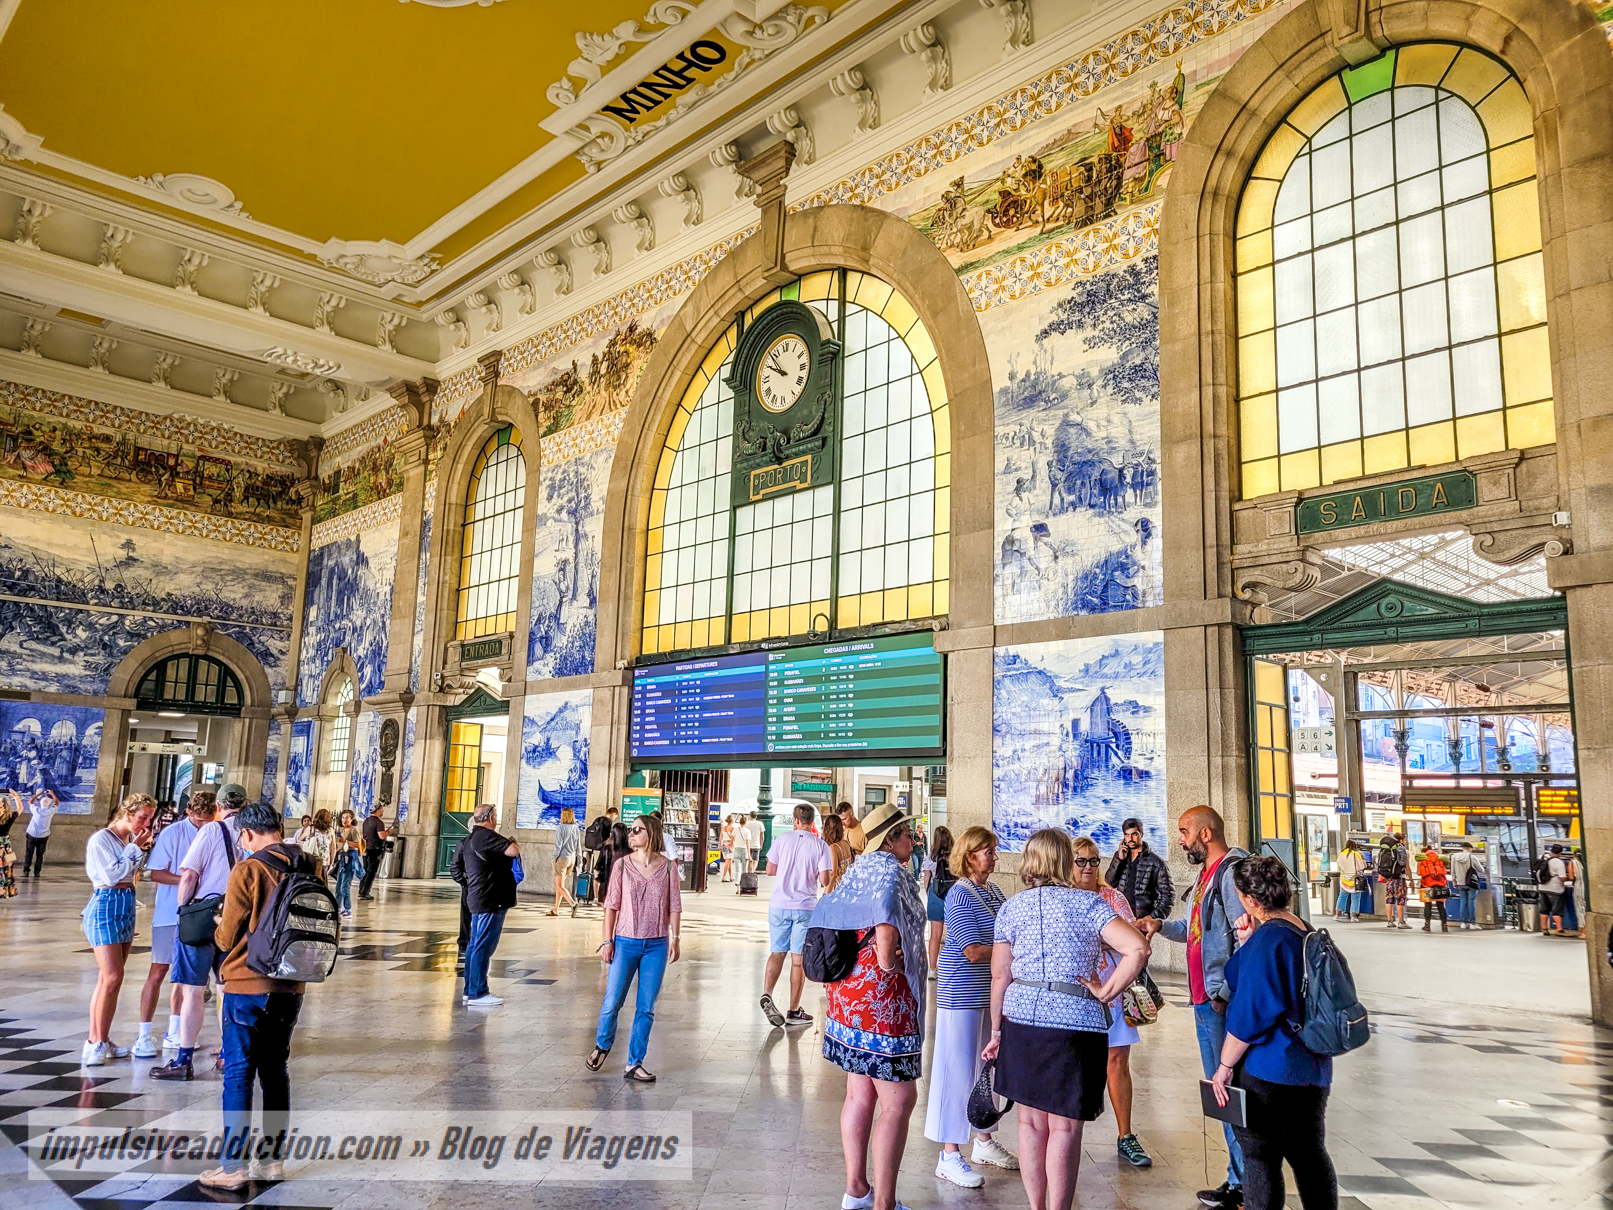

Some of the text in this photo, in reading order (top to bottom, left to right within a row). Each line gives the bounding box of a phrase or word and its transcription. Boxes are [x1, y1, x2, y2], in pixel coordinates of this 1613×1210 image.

[601, 40, 726, 124] MINHO
[759, 463, 800, 489] PORTO
[1320, 482, 1450, 524] SAIDA
[464, 642, 499, 659] ENTRADA
[824, 646, 848, 654] CHEGADAS
[851, 643, 874, 651] ARRIVALS
[695, 661, 718, 669] DEPARTURES
[792, 783, 833, 792] THE PASSENGER
